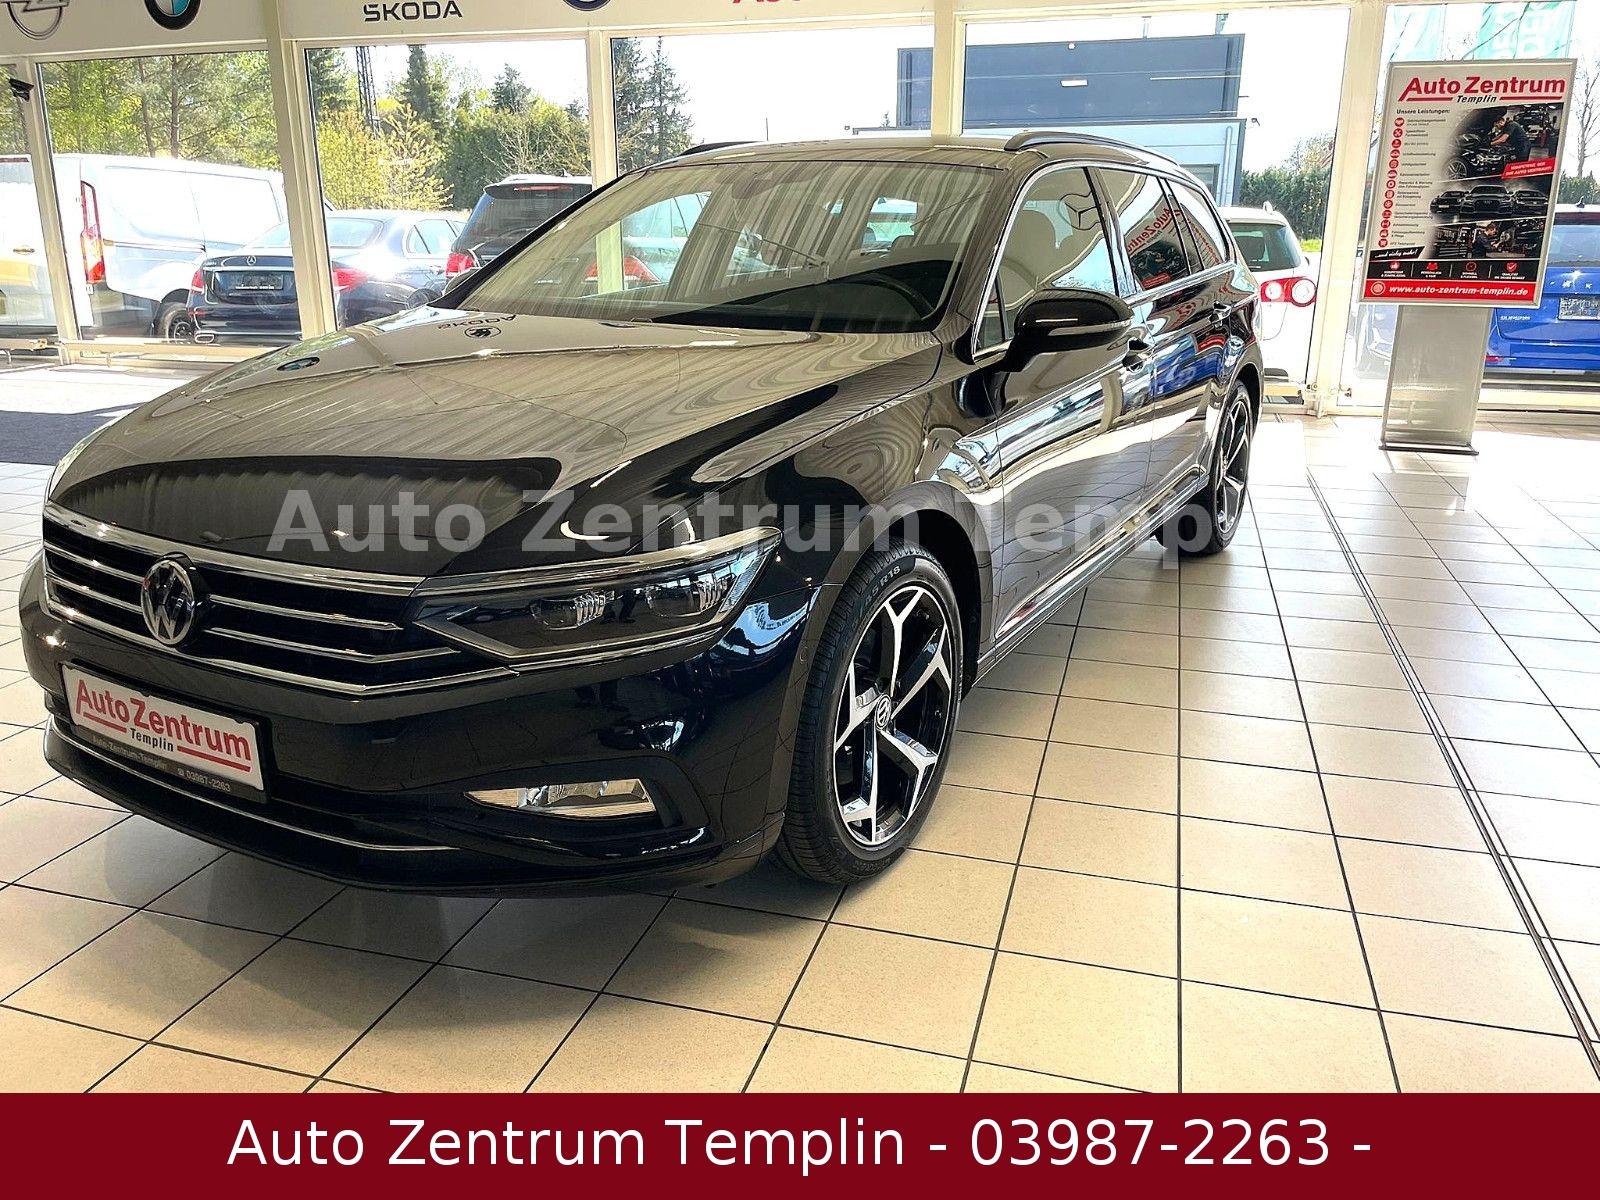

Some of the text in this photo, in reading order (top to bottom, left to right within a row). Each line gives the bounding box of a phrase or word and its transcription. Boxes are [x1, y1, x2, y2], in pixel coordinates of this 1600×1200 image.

[1398, 76, 1566, 101] Auto Zentrum
[1456, 95, 1498, 105] Templin
[1388, 286, 1529, 296] www.auto-zentrum-templin.de
[76, 679, 251, 761] Auto Zentrum
[130, 727, 174, 752] Templin
